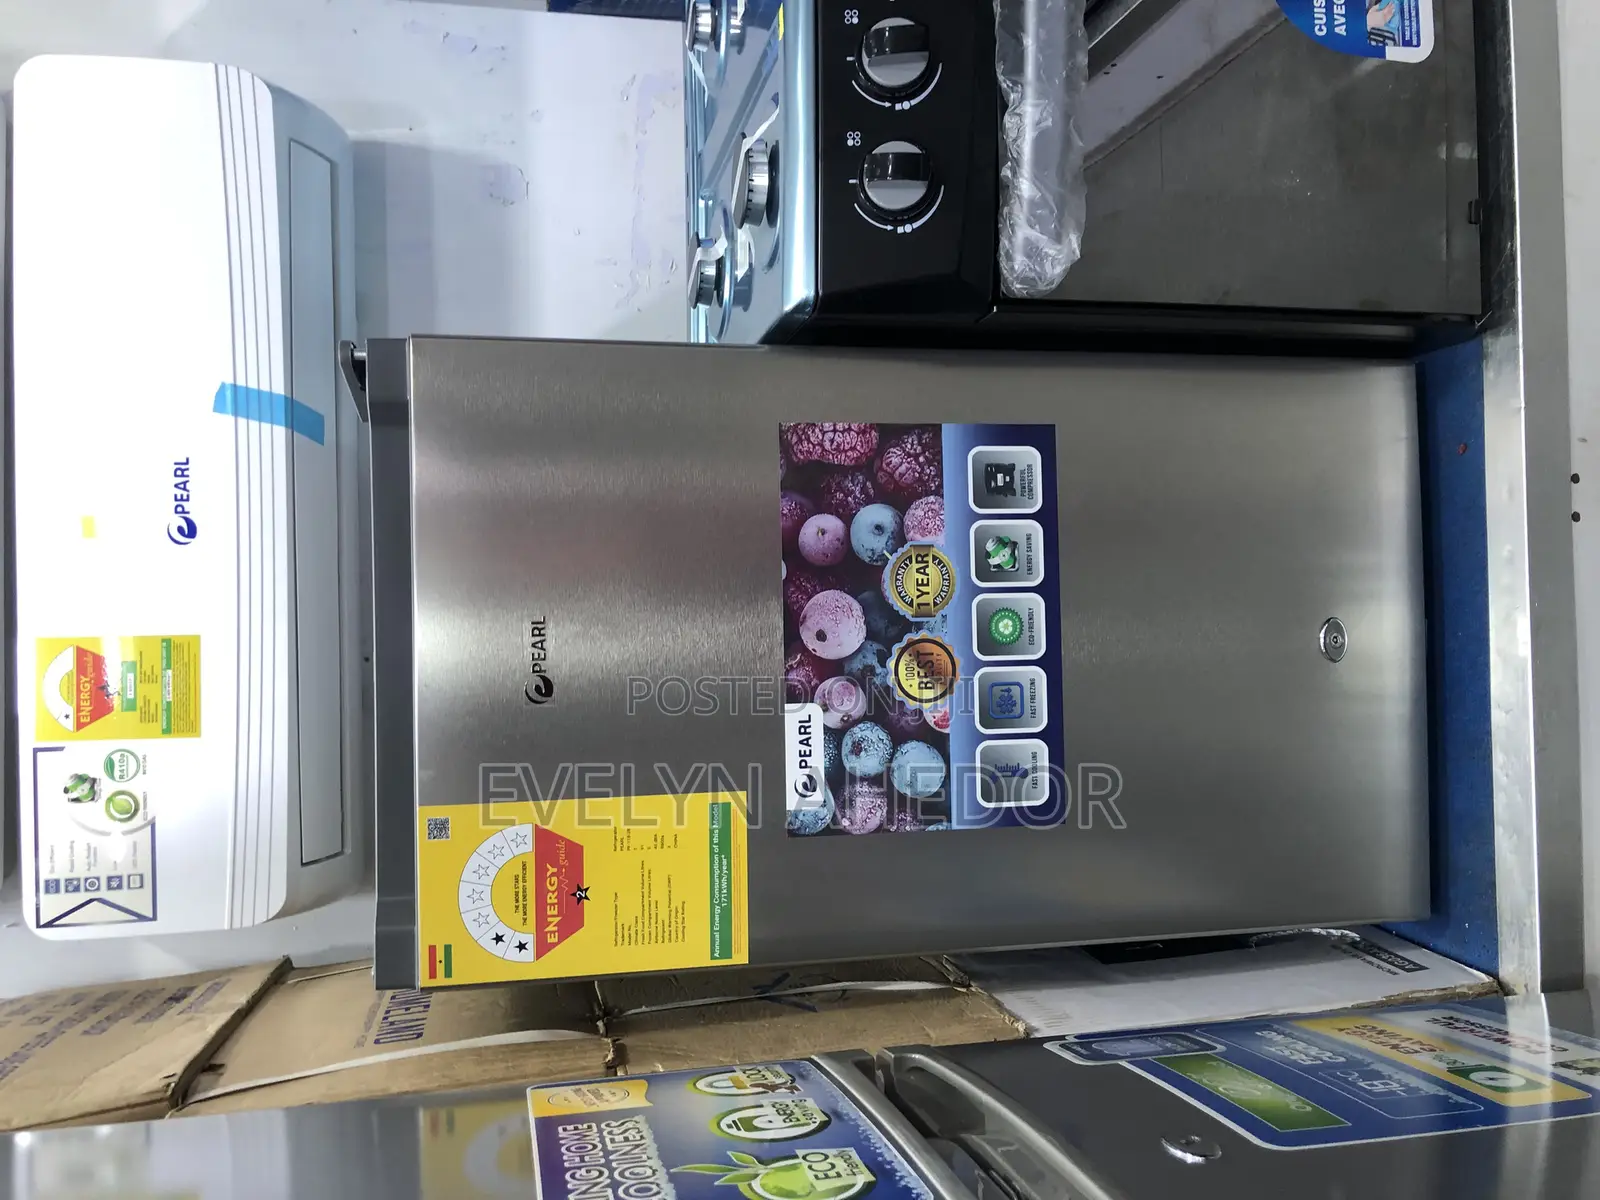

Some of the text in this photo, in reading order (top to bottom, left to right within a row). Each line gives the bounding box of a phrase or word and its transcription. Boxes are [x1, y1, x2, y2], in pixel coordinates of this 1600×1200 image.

[174, 457, 190, 515] PEARL
[1026, 463, 1034, 500] COMPRESSOR
[895, 558, 912, 604] WARRANTY
[915, 553, 930, 601] YEAR
[932, 558, 950, 604] WARRANTY
[1026, 555, 1034, 575] ENERGY
[530, 616, 546, 674] PEARL
[904, 658, 915, 682] 100%
[916, 650, 934, 690] BEST
[78, 676, 94, 723] ENERGY
[798, 714, 813, 769] PEARL
[556, 839, 568, 866] guide
[712, 844, 719, 852] of
[544, 863, 562, 943] ENERGY
[771, 1101, 800, 1123] ENERGY
[558, 1122, 606, 1168] HOME
[801, 1152, 843, 1180] ECO
[834, 1149, 864, 1176] friendly
